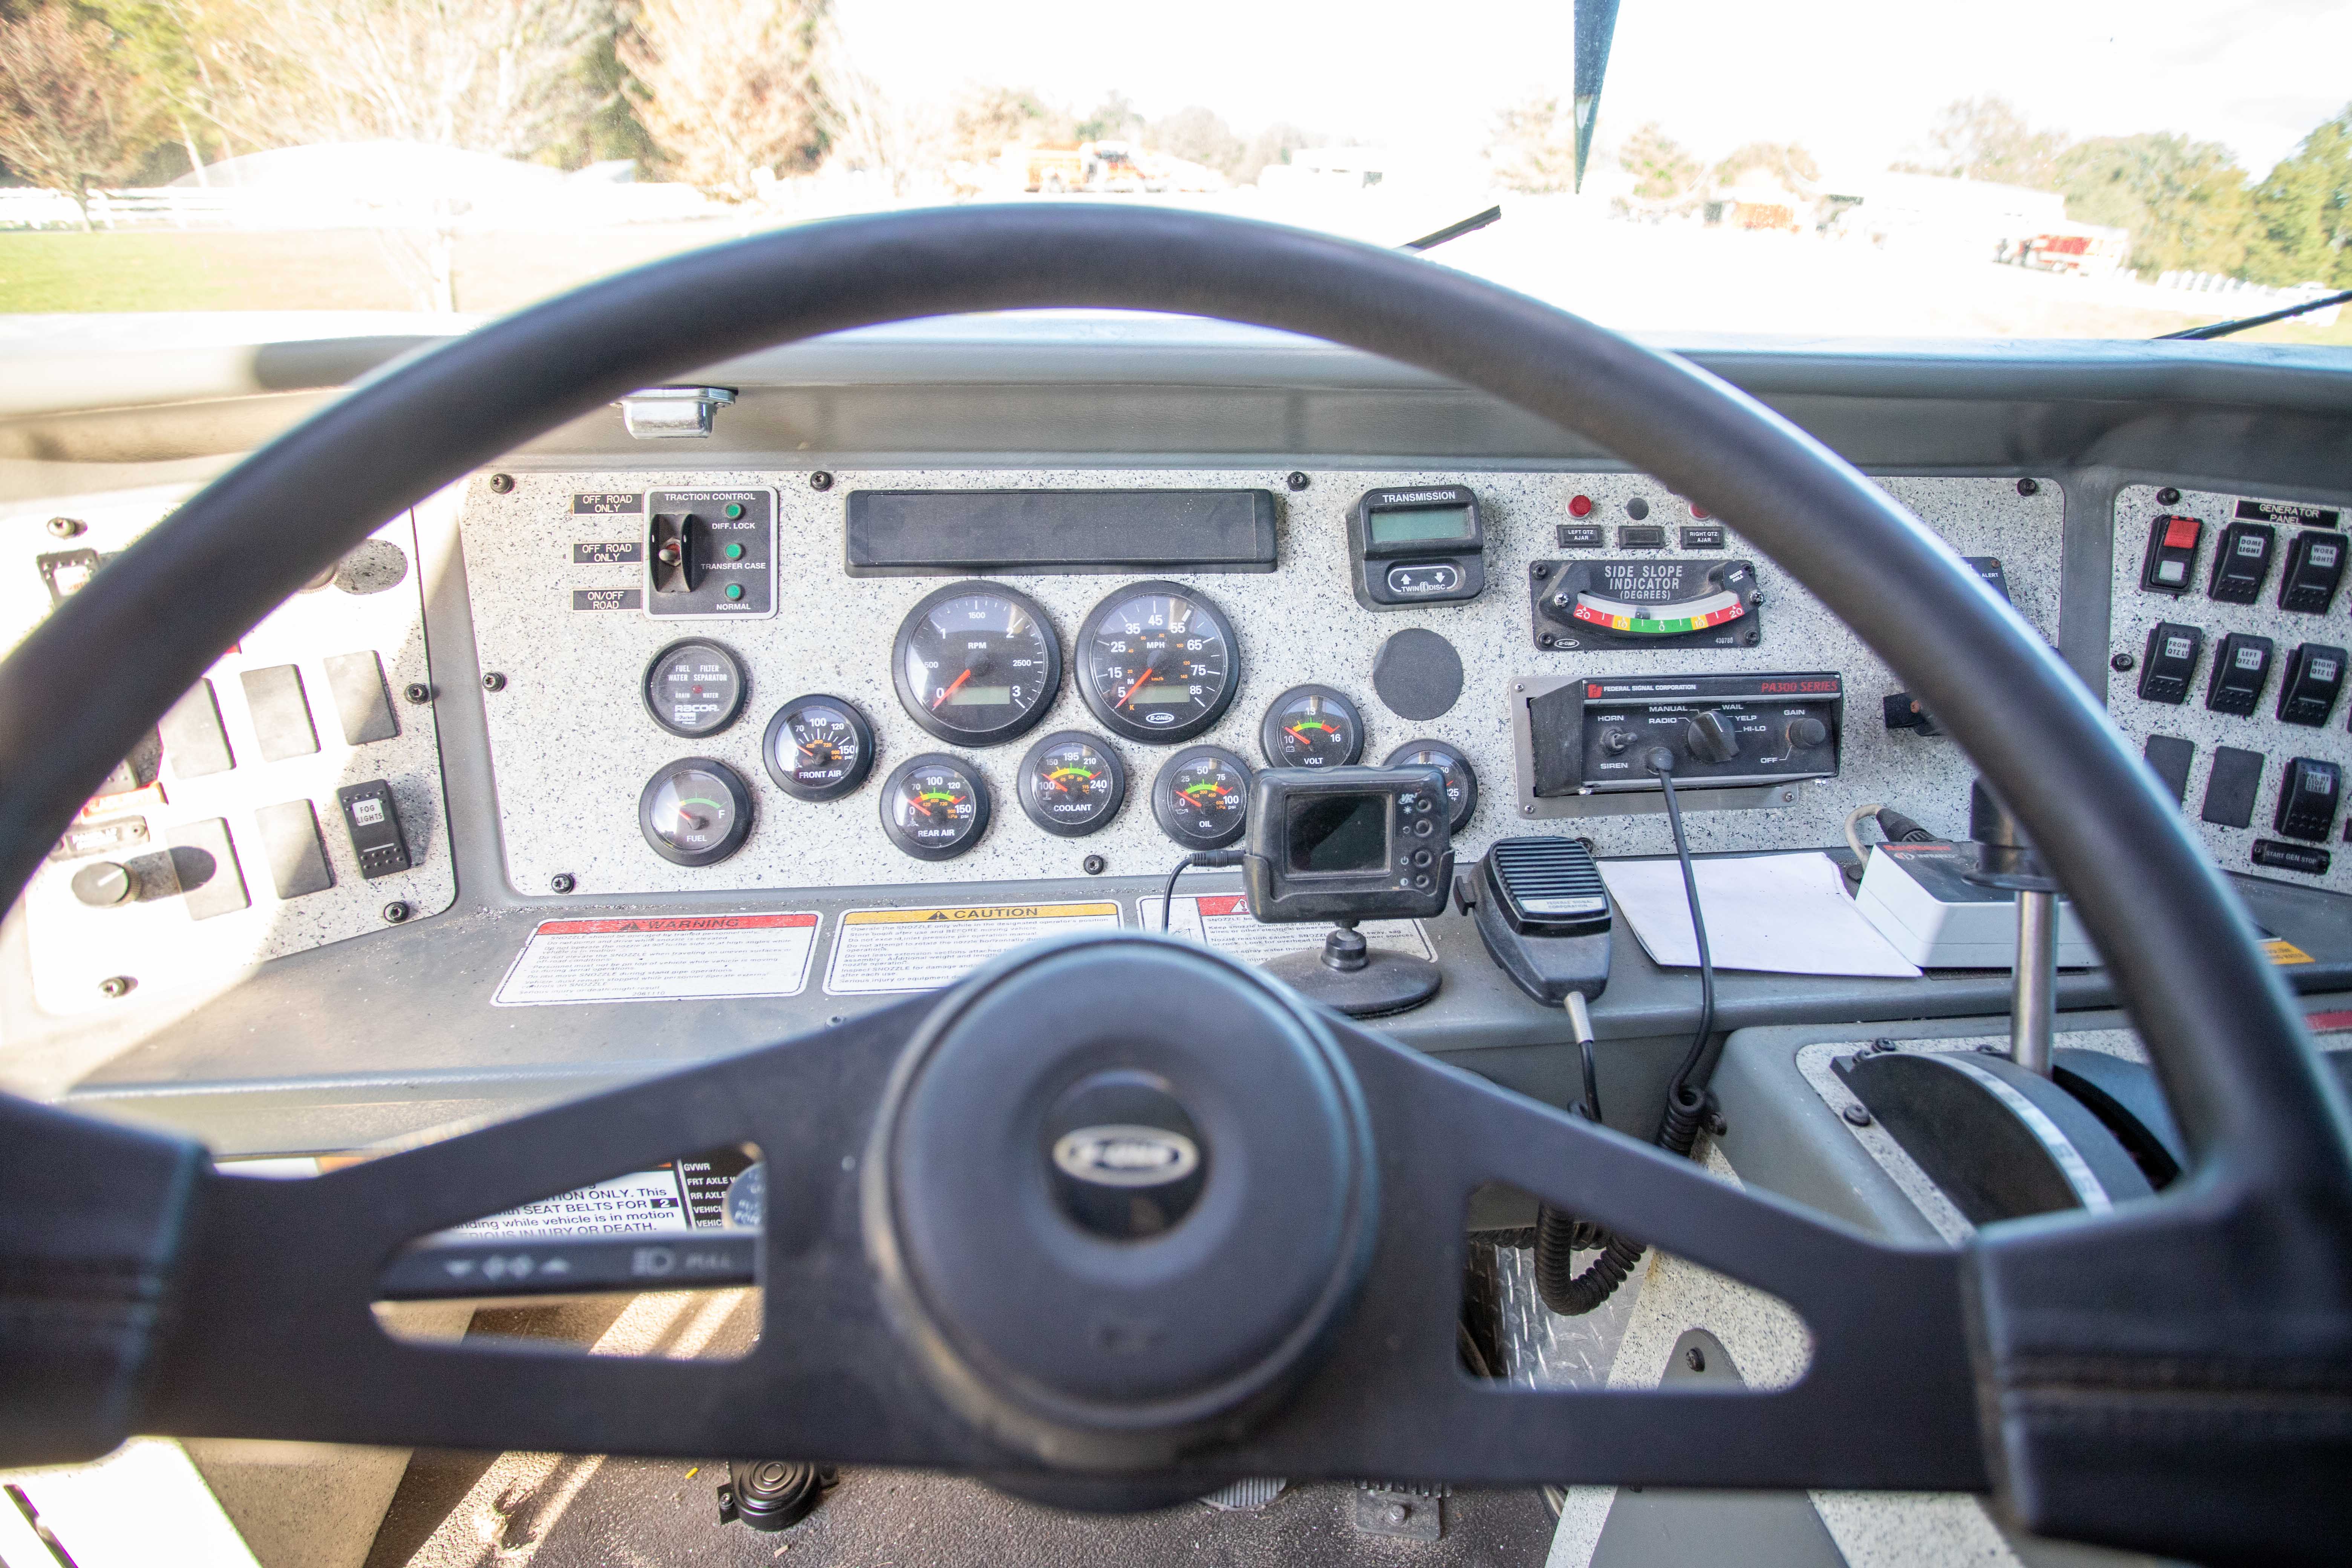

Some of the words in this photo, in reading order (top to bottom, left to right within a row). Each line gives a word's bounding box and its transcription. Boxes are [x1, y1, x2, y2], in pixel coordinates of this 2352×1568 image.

[1383, 492, 1455, 503] TRANSMISSION
[2259, 504, 2319, 518] GENERATOR
[2270, 515, 2300, 525] PANEL
[2309, 554, 2334, 563] LIGHTS
[1605, 566, 1633, 577] SIDE
[1643, 566, 1682, 577] SLOPE
[1610, 578, 1679, 589] INDICATOR
[588, 591, 624, 600] ON/OFF
[1620, 590, 1670, 600] (DEGREES)
[593, 601, 619, 609] ROAD
[1576, 609, 1590, 619] 20
[1729, 608, 1743, 618] 20
[1148, 615, 1163, 625] 45
[1617, 620, 1627, 629] 10
[1125, 623, 1140, 634] 35
[1171, 623, 1185, 633] 55
[1659, 623, 1664, 631] 0
[940, 628, 946, 639] 1
[1006, 627, 1014, 638] 2
[1111, 642, 1125, 652] 25
[1187, 640, 1202, 650] 65
[2314, 660, 2335, 669] RIGHT
[1108, 667, 1122, 678] 15
[1191, 665, 1206, 676] 75
[1012, 686, 1021, 697] 3
[1190, 686, 1202, 695] 85
[1761, 683, 1797, 692] PA300
[1801, 681, 1838, 691] SERIES
[937, 688, 945, 698] 0
[1118, 687, 1125, 697] 5
[810, 718, 826, 727] 100
[839, 746, 854, 754] 150
[1064, 752, 1079, 761] 195
[926, 777, 943, 785] 100
[1039, 782, 1055, 790] 100
[1090, 780, 1107, 789] 240
[1223, 795, 1239, 804] 100
[360, 805, 375, 813] FOG
[718, 810, 725, 818] F
[955, 805, 971, 813] 150
[357, 813, 382, 823] LIGHTS
[2301, 856, 2317, 864] STOP
[954, 908, 1038, 919] CAUTION
[648, 919, 739, 929] WARNING
[590, 1190, 634, 1199] ONLY.
[524, 1205, 561, 1214] SEAT
[566, 1203, 612, 1213] BELTS
[617, 1200, 646, 1209] FOR
[660, 1199, 670, 1207] 2
[542, 1215, 590, 1225] vehicle
[626, 1211, 674, 1220] motion
[578, 1227, 599, 1235] OR
[603, 1223, 656, 1233] DEATH.
